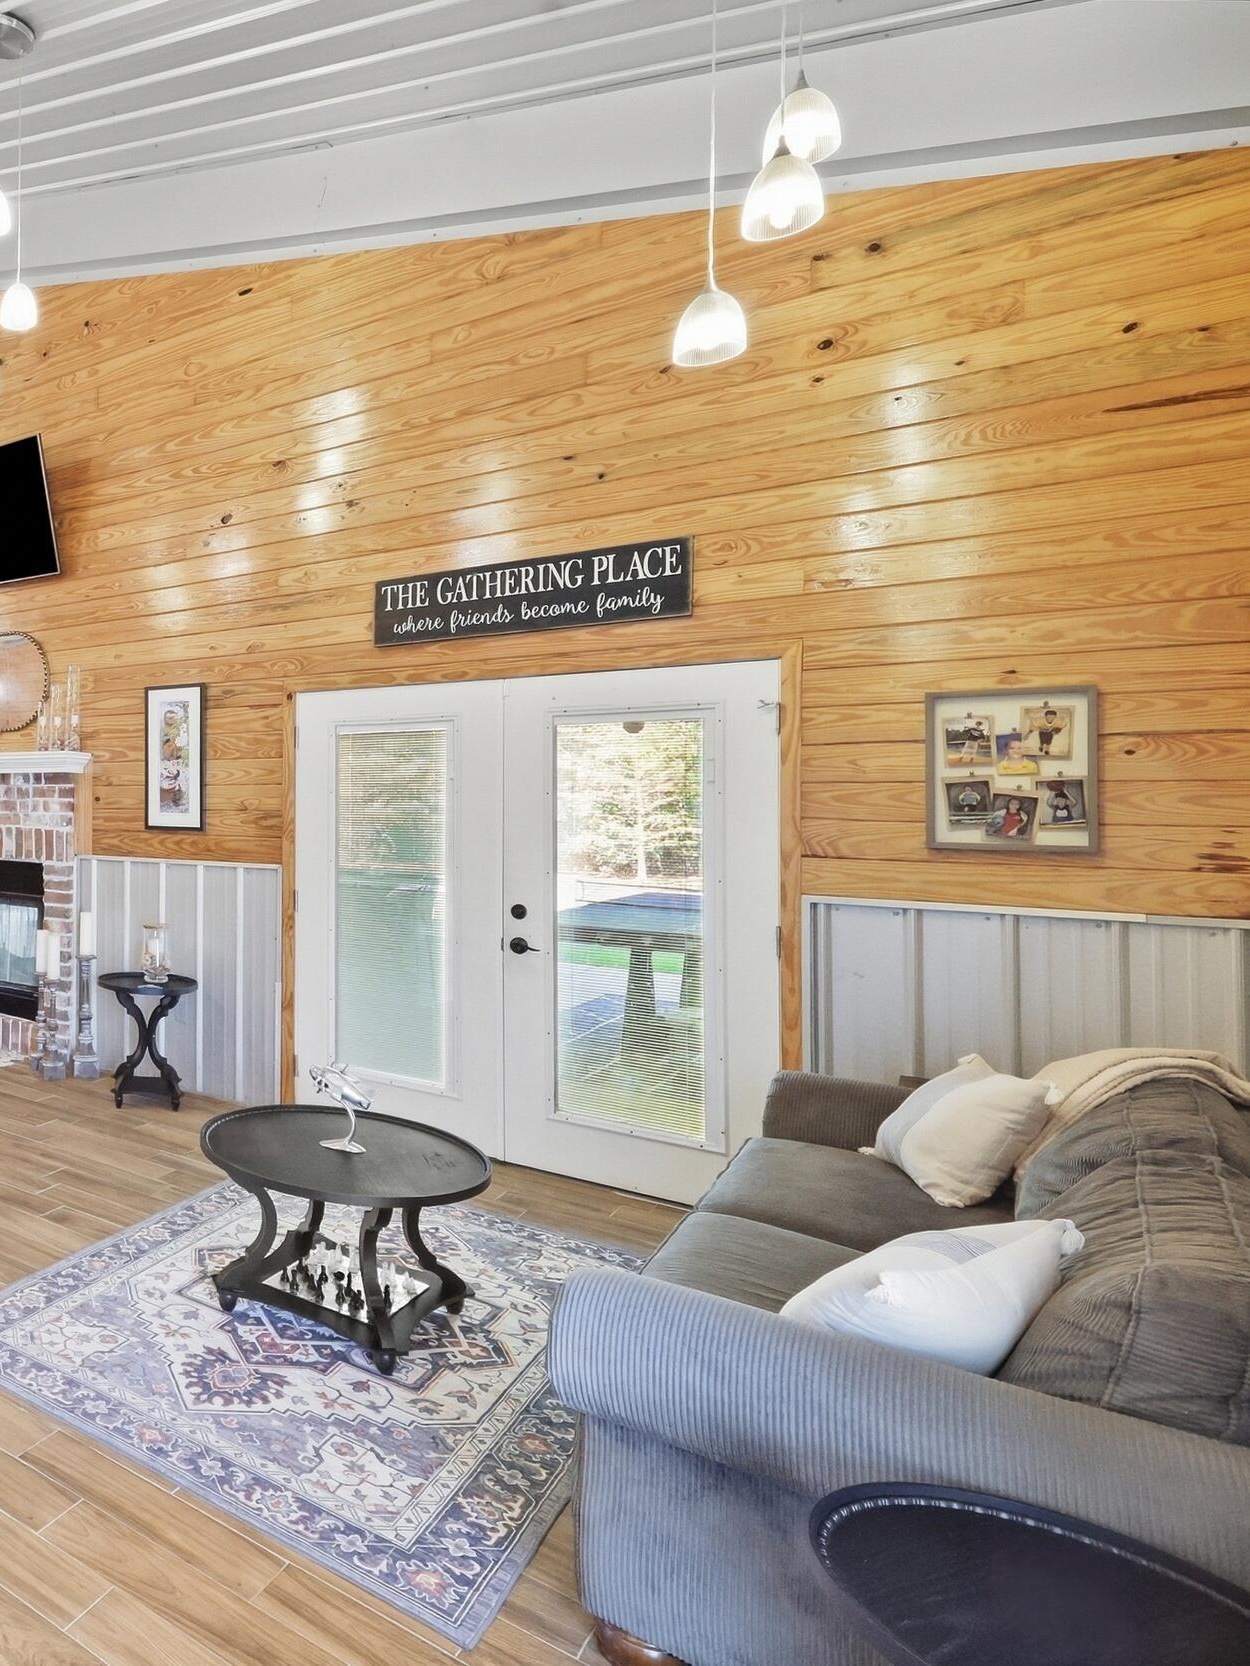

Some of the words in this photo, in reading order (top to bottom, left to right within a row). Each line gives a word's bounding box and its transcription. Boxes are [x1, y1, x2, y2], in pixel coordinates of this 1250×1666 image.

[381, 581, 429, 611] THE
[436, 559, 584, 605] GATHERING
[590, 544, 682, 586] PLACE
[393, 613, 444, 635] where
[450, 604, 514, 633] friends
[521, 598, 589, 620] become
[596, 586, 665, 617] family
